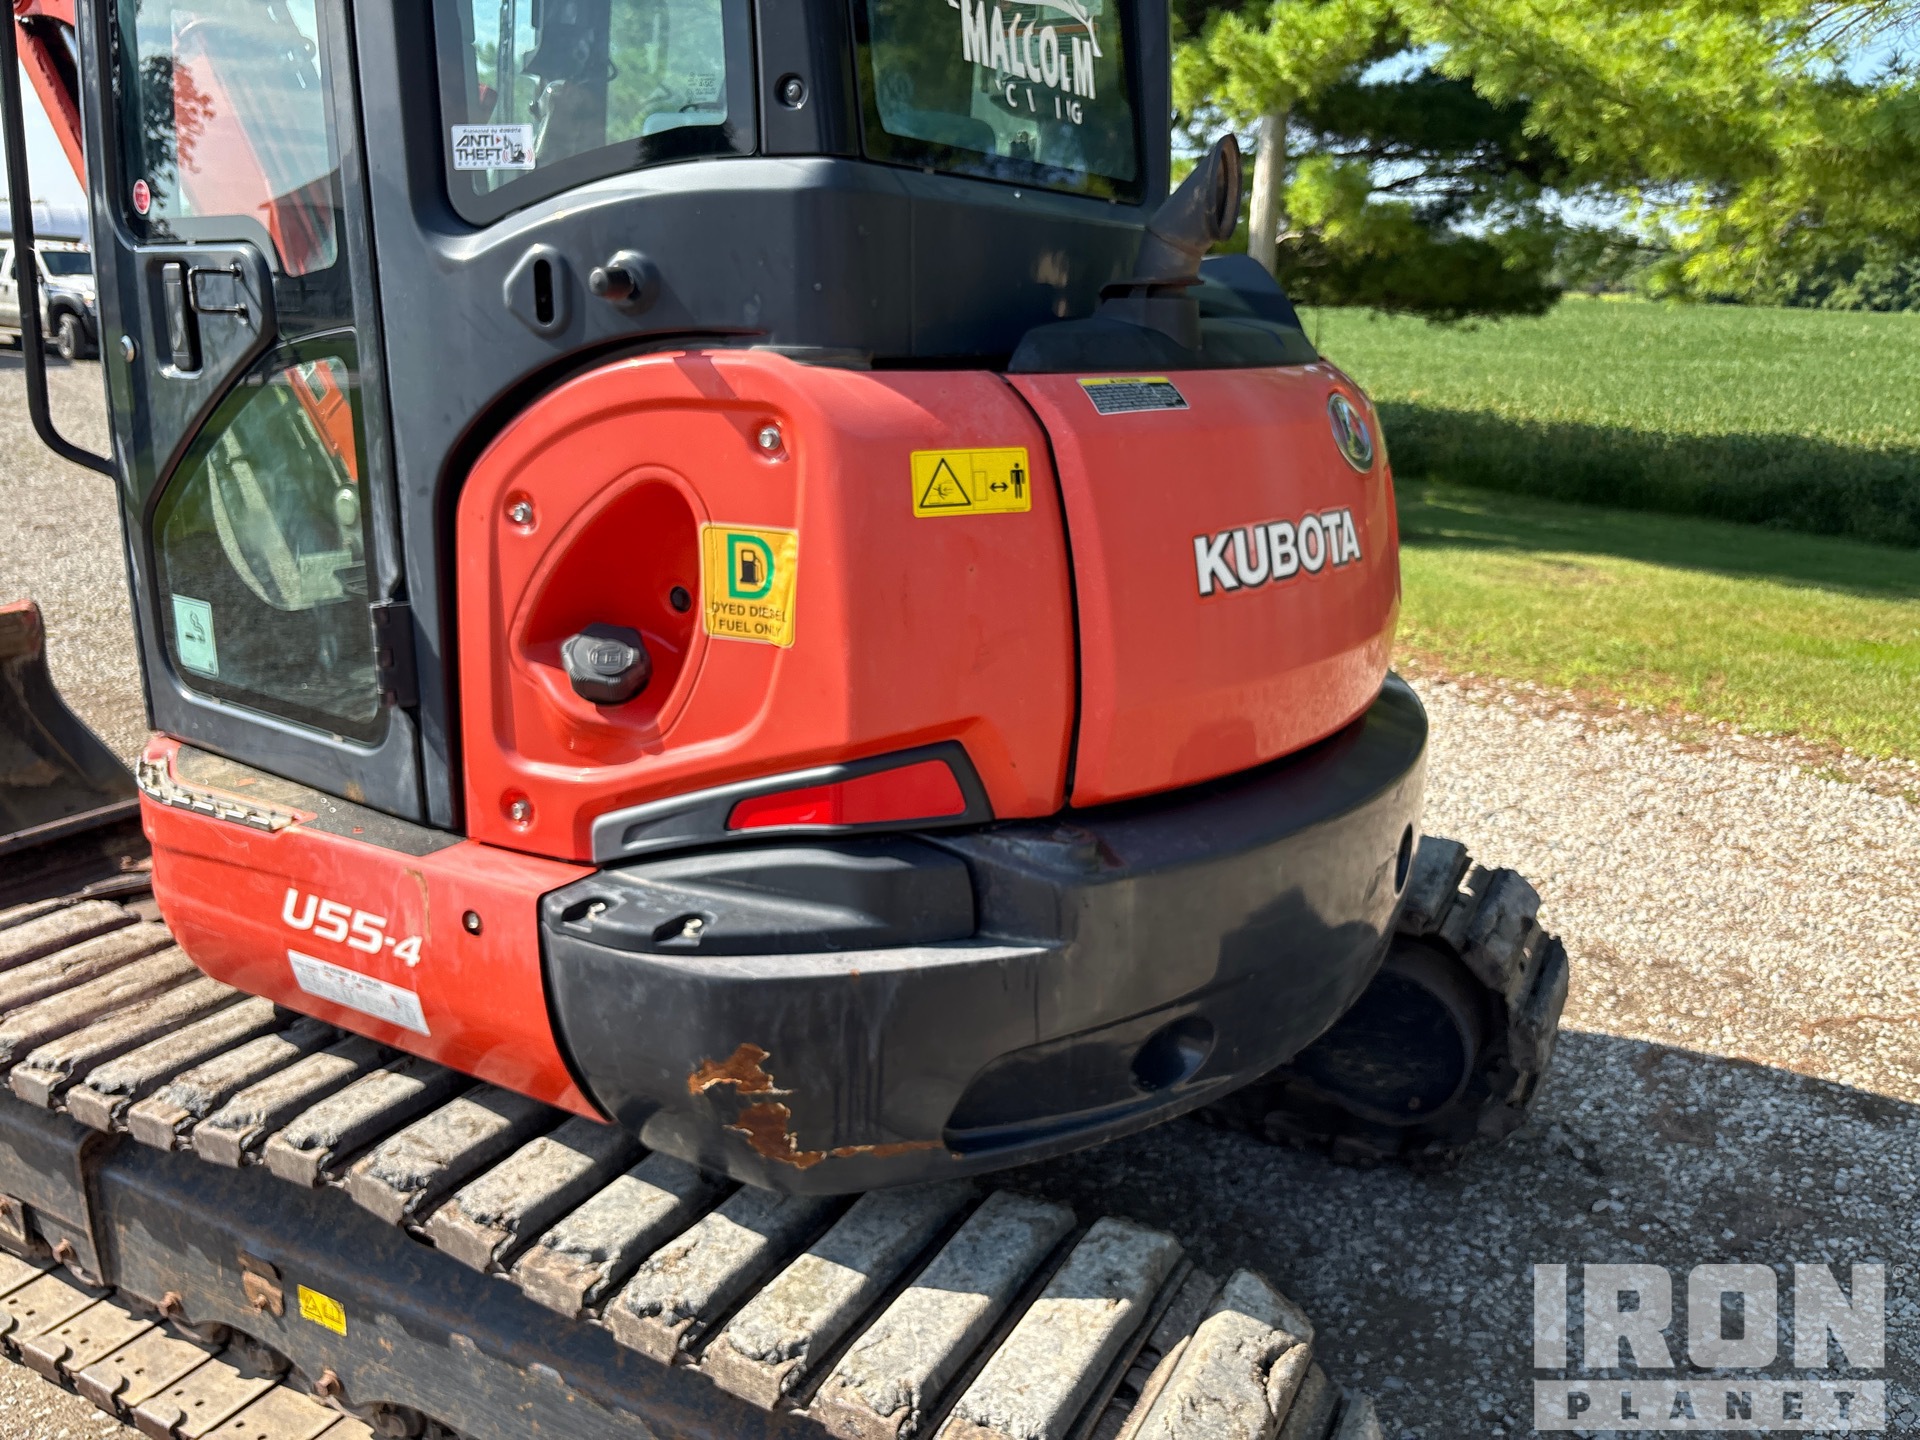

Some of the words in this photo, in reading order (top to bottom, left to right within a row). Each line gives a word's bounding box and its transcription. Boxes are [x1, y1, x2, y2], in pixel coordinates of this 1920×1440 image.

[456, 134, 494, 147] ANTI
[455, 148, 502, 161] THEFT
[1193, 508, 1362, 596] KUBOTA
[711, 601, 746, 617] DYED
[749, 605, 787, 623] DIESEL
[718, 618, 751, 634] FUEL
[282, 887, 423, 968] U55-4
